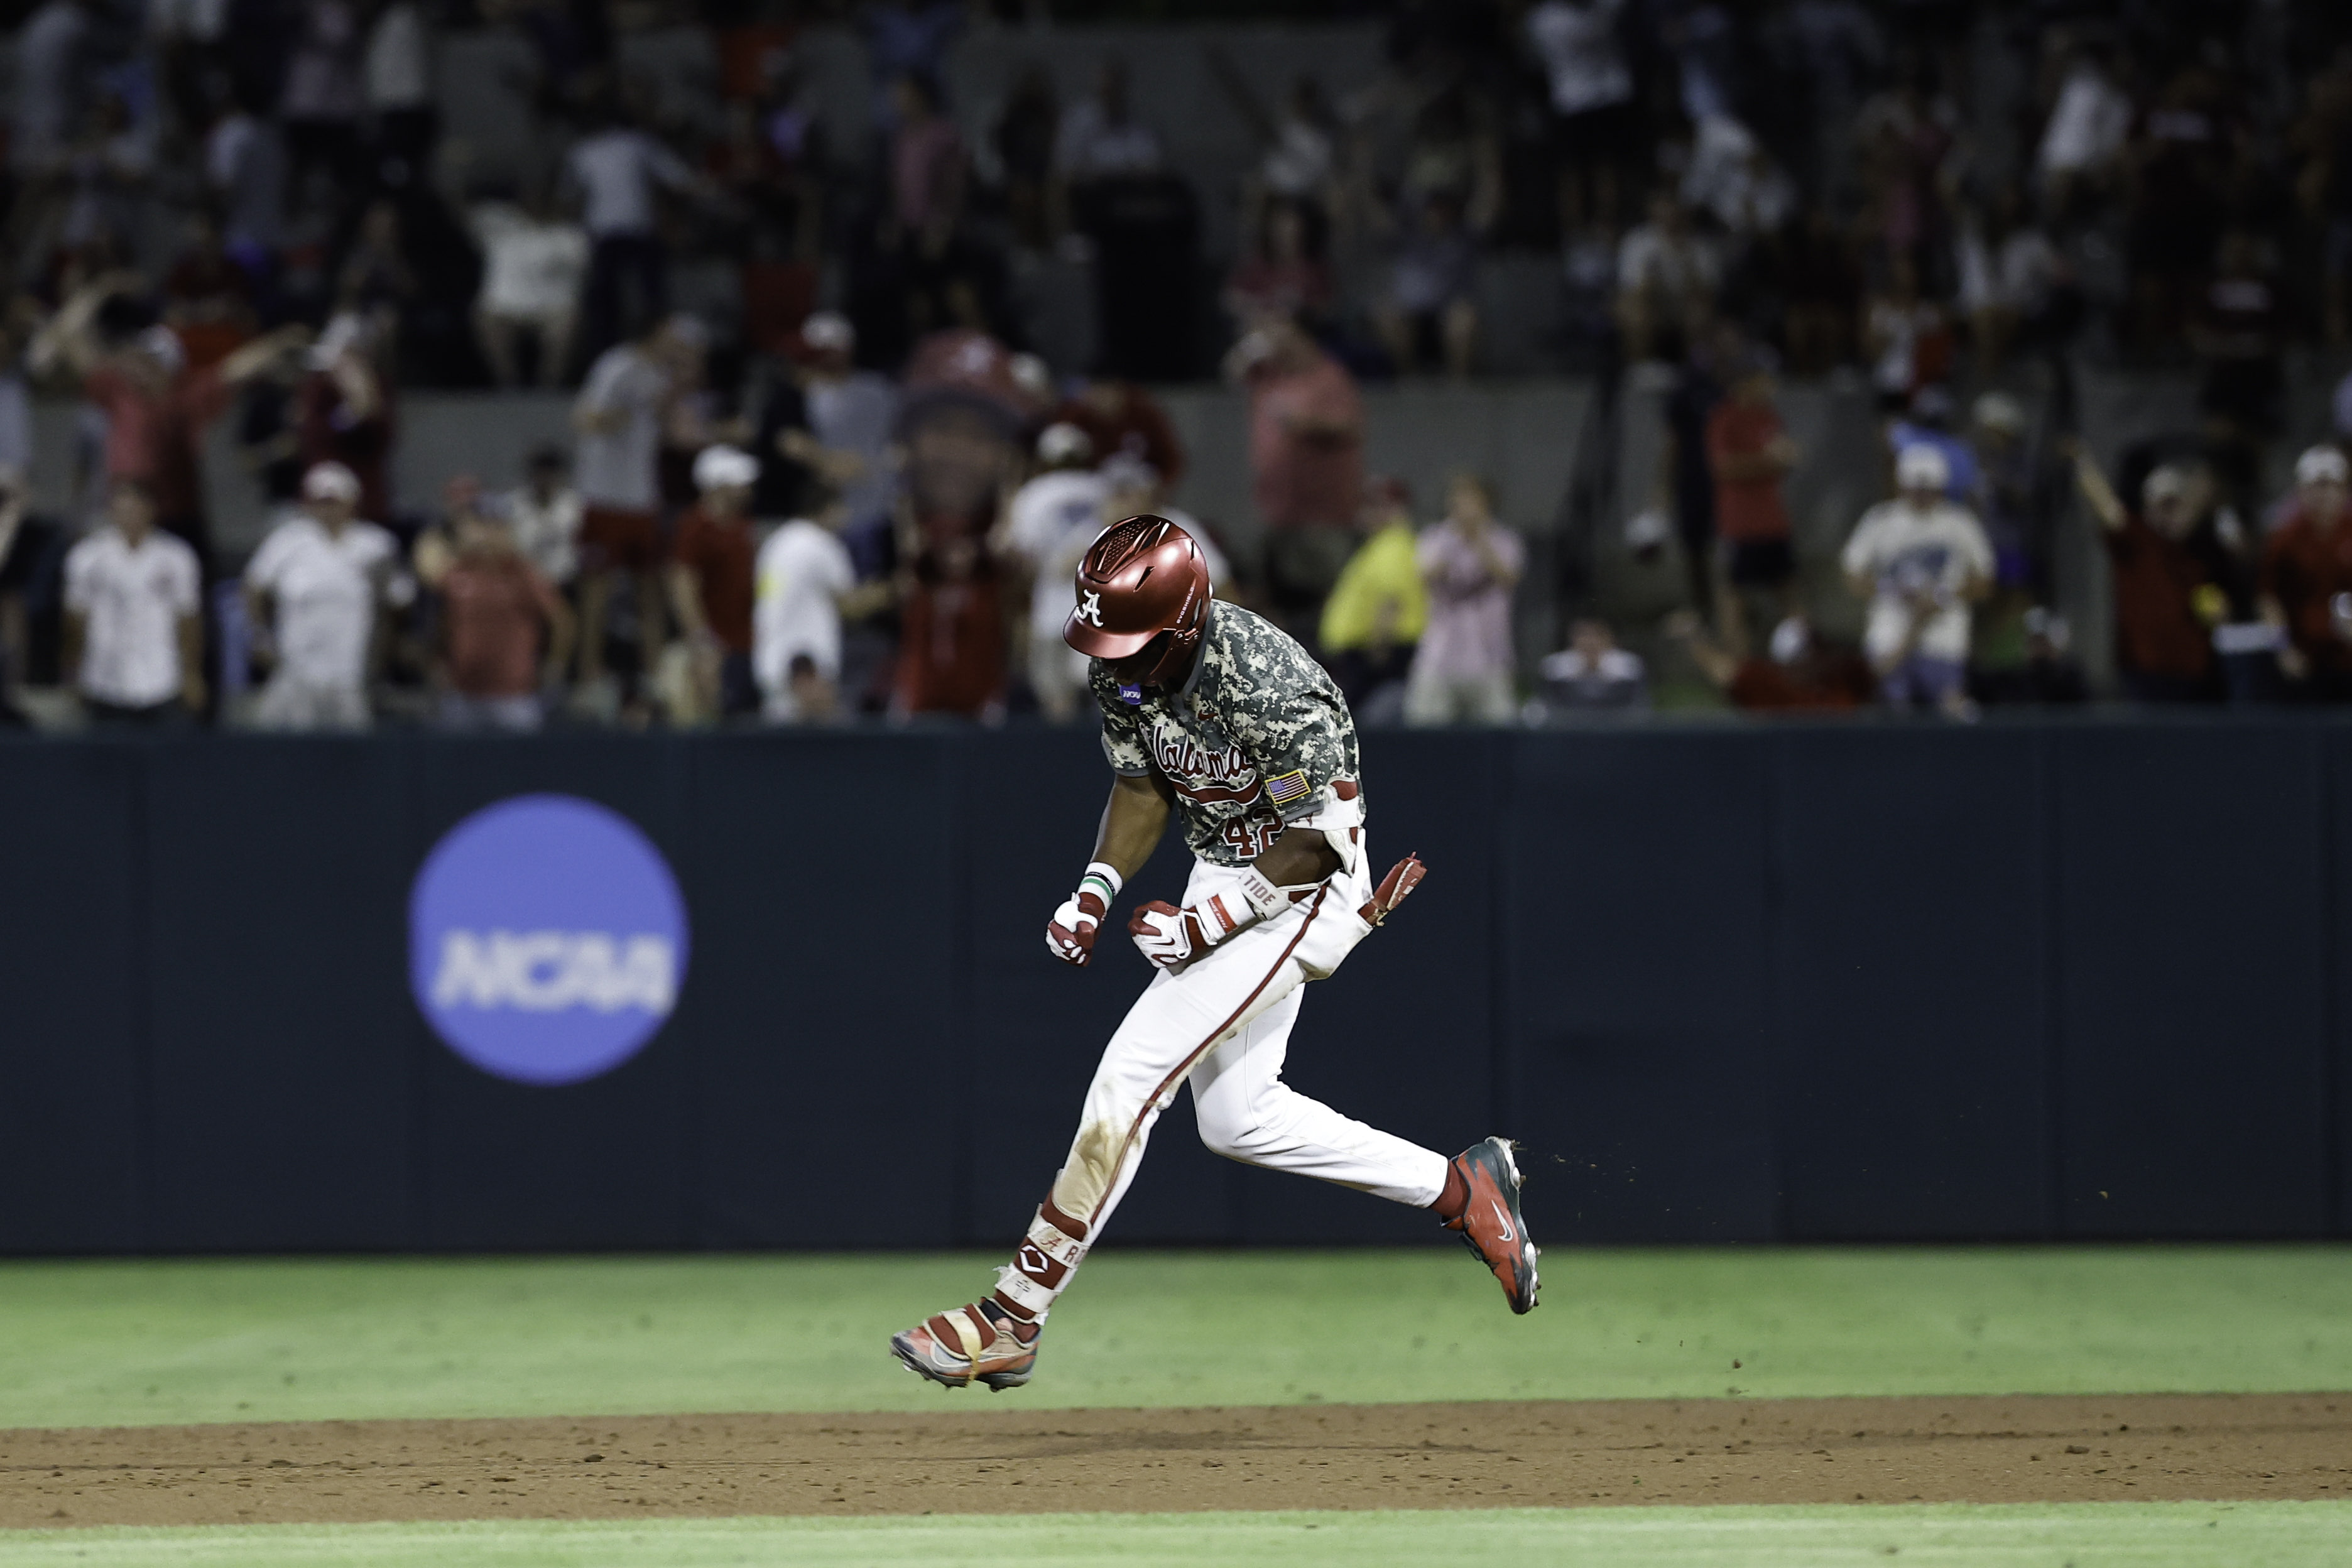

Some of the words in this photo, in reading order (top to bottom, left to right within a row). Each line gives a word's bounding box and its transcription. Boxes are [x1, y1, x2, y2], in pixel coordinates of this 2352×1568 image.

[1075, 589, 1104, 627] A
[1221, 807, 1286, 858] 42
[1244, 874, 1276, 906] TIDE
[432, 927, 677, 1014] NCAA
